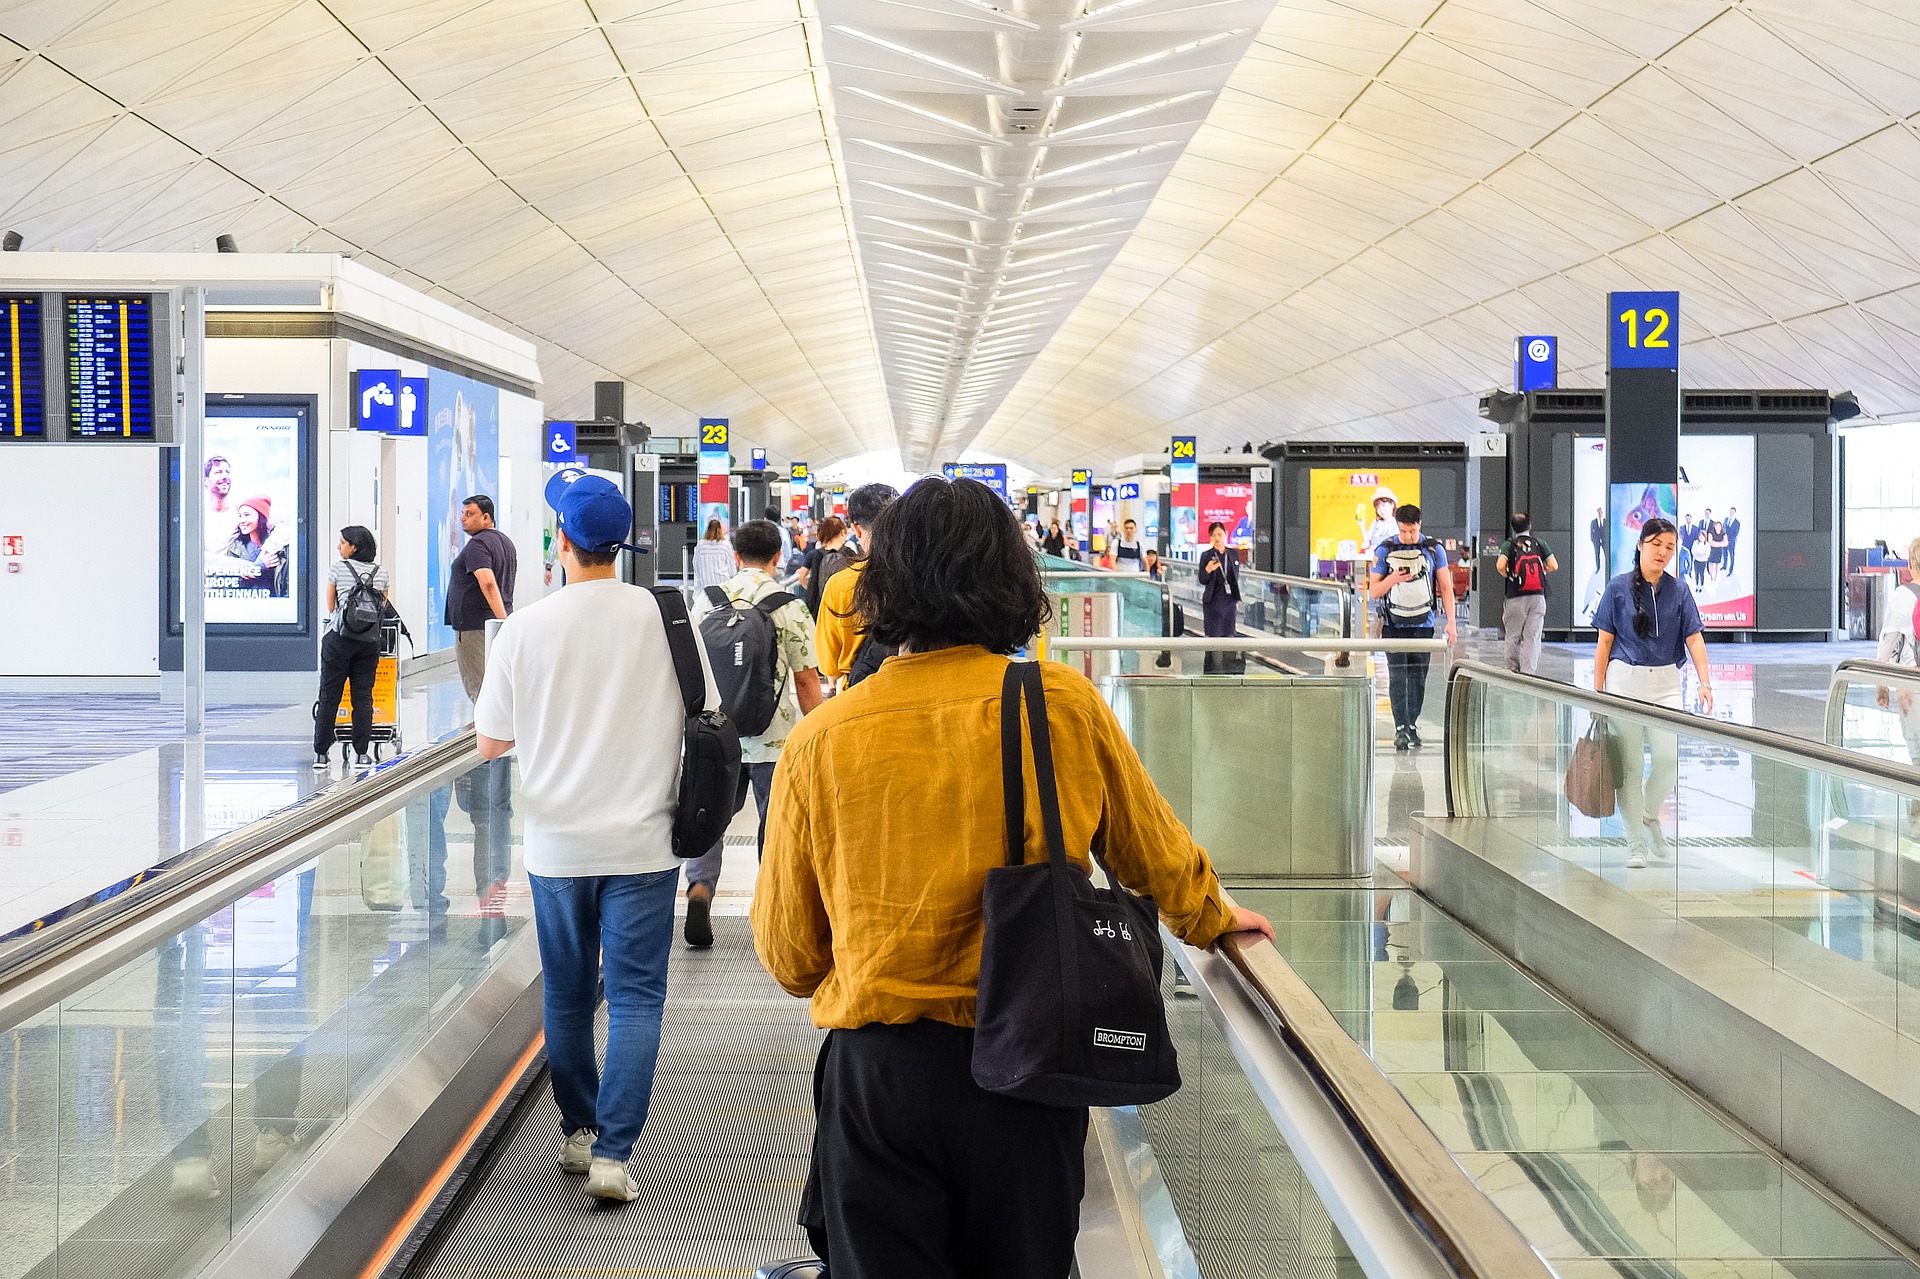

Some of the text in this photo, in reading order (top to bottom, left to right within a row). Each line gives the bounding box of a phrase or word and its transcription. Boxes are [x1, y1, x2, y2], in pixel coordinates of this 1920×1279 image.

[1620, 308, 1669, 348] 12
[702, 425, 727, 444] 23
[1173, 441, 1194, 457] 24
[792, 465, 808, 478] 25
[226, 589, 270, 598] FINNAIR
[1700, 611, 1723, 621] Dream
[1736, 611, 1746, 621] Us
[1097, 1032, 1142, 1047] BROMPTON
